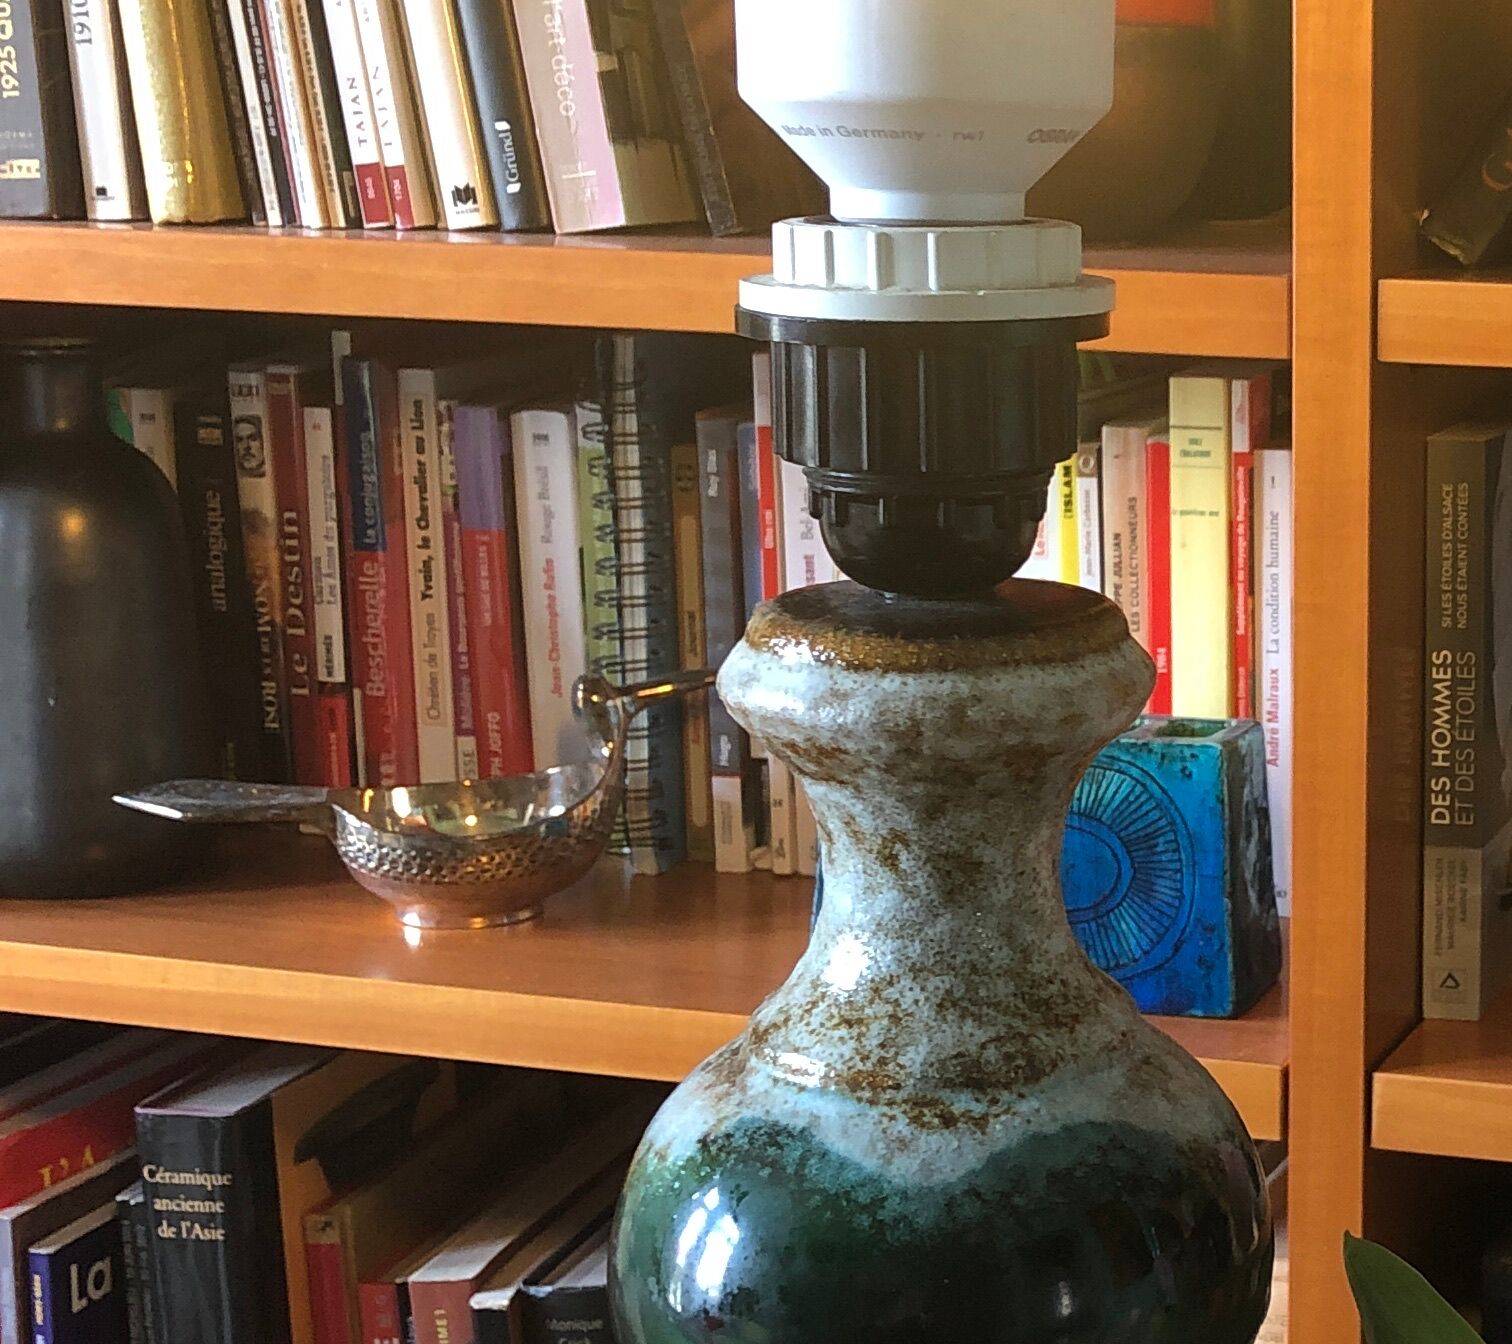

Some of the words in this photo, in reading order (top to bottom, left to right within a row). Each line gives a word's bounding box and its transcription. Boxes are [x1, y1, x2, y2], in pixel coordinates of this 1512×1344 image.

[1, 44, 19, 99] 1925
[551, 53, 576, 117] déco
[837, 123, 925, 142] Germany
[1266, 511, 1280, 567] humaine
[281, 509, 306, 641] Destin
[1266, 569, 1280, 633] condition
[358, 560, 387, 697] Bescherelle
[1266, 635, 1280, 655] La
[290, 650, 310, 698] Le
[1266, 667, 1280, 718] Malraux
[1431, 649, 1452, 765] HOMMES
[1266, 720, 1280, 767] André
[1455, 747, 1475, 794] DES
[1431, 774, 1451, 825] DES
[1454, 803, 1474, 825] ET
[142, 1165, 234, 1188] Céramique
[153, 1195, 226, 1214] ancienne
[157, 1220, 178, 1239] de
